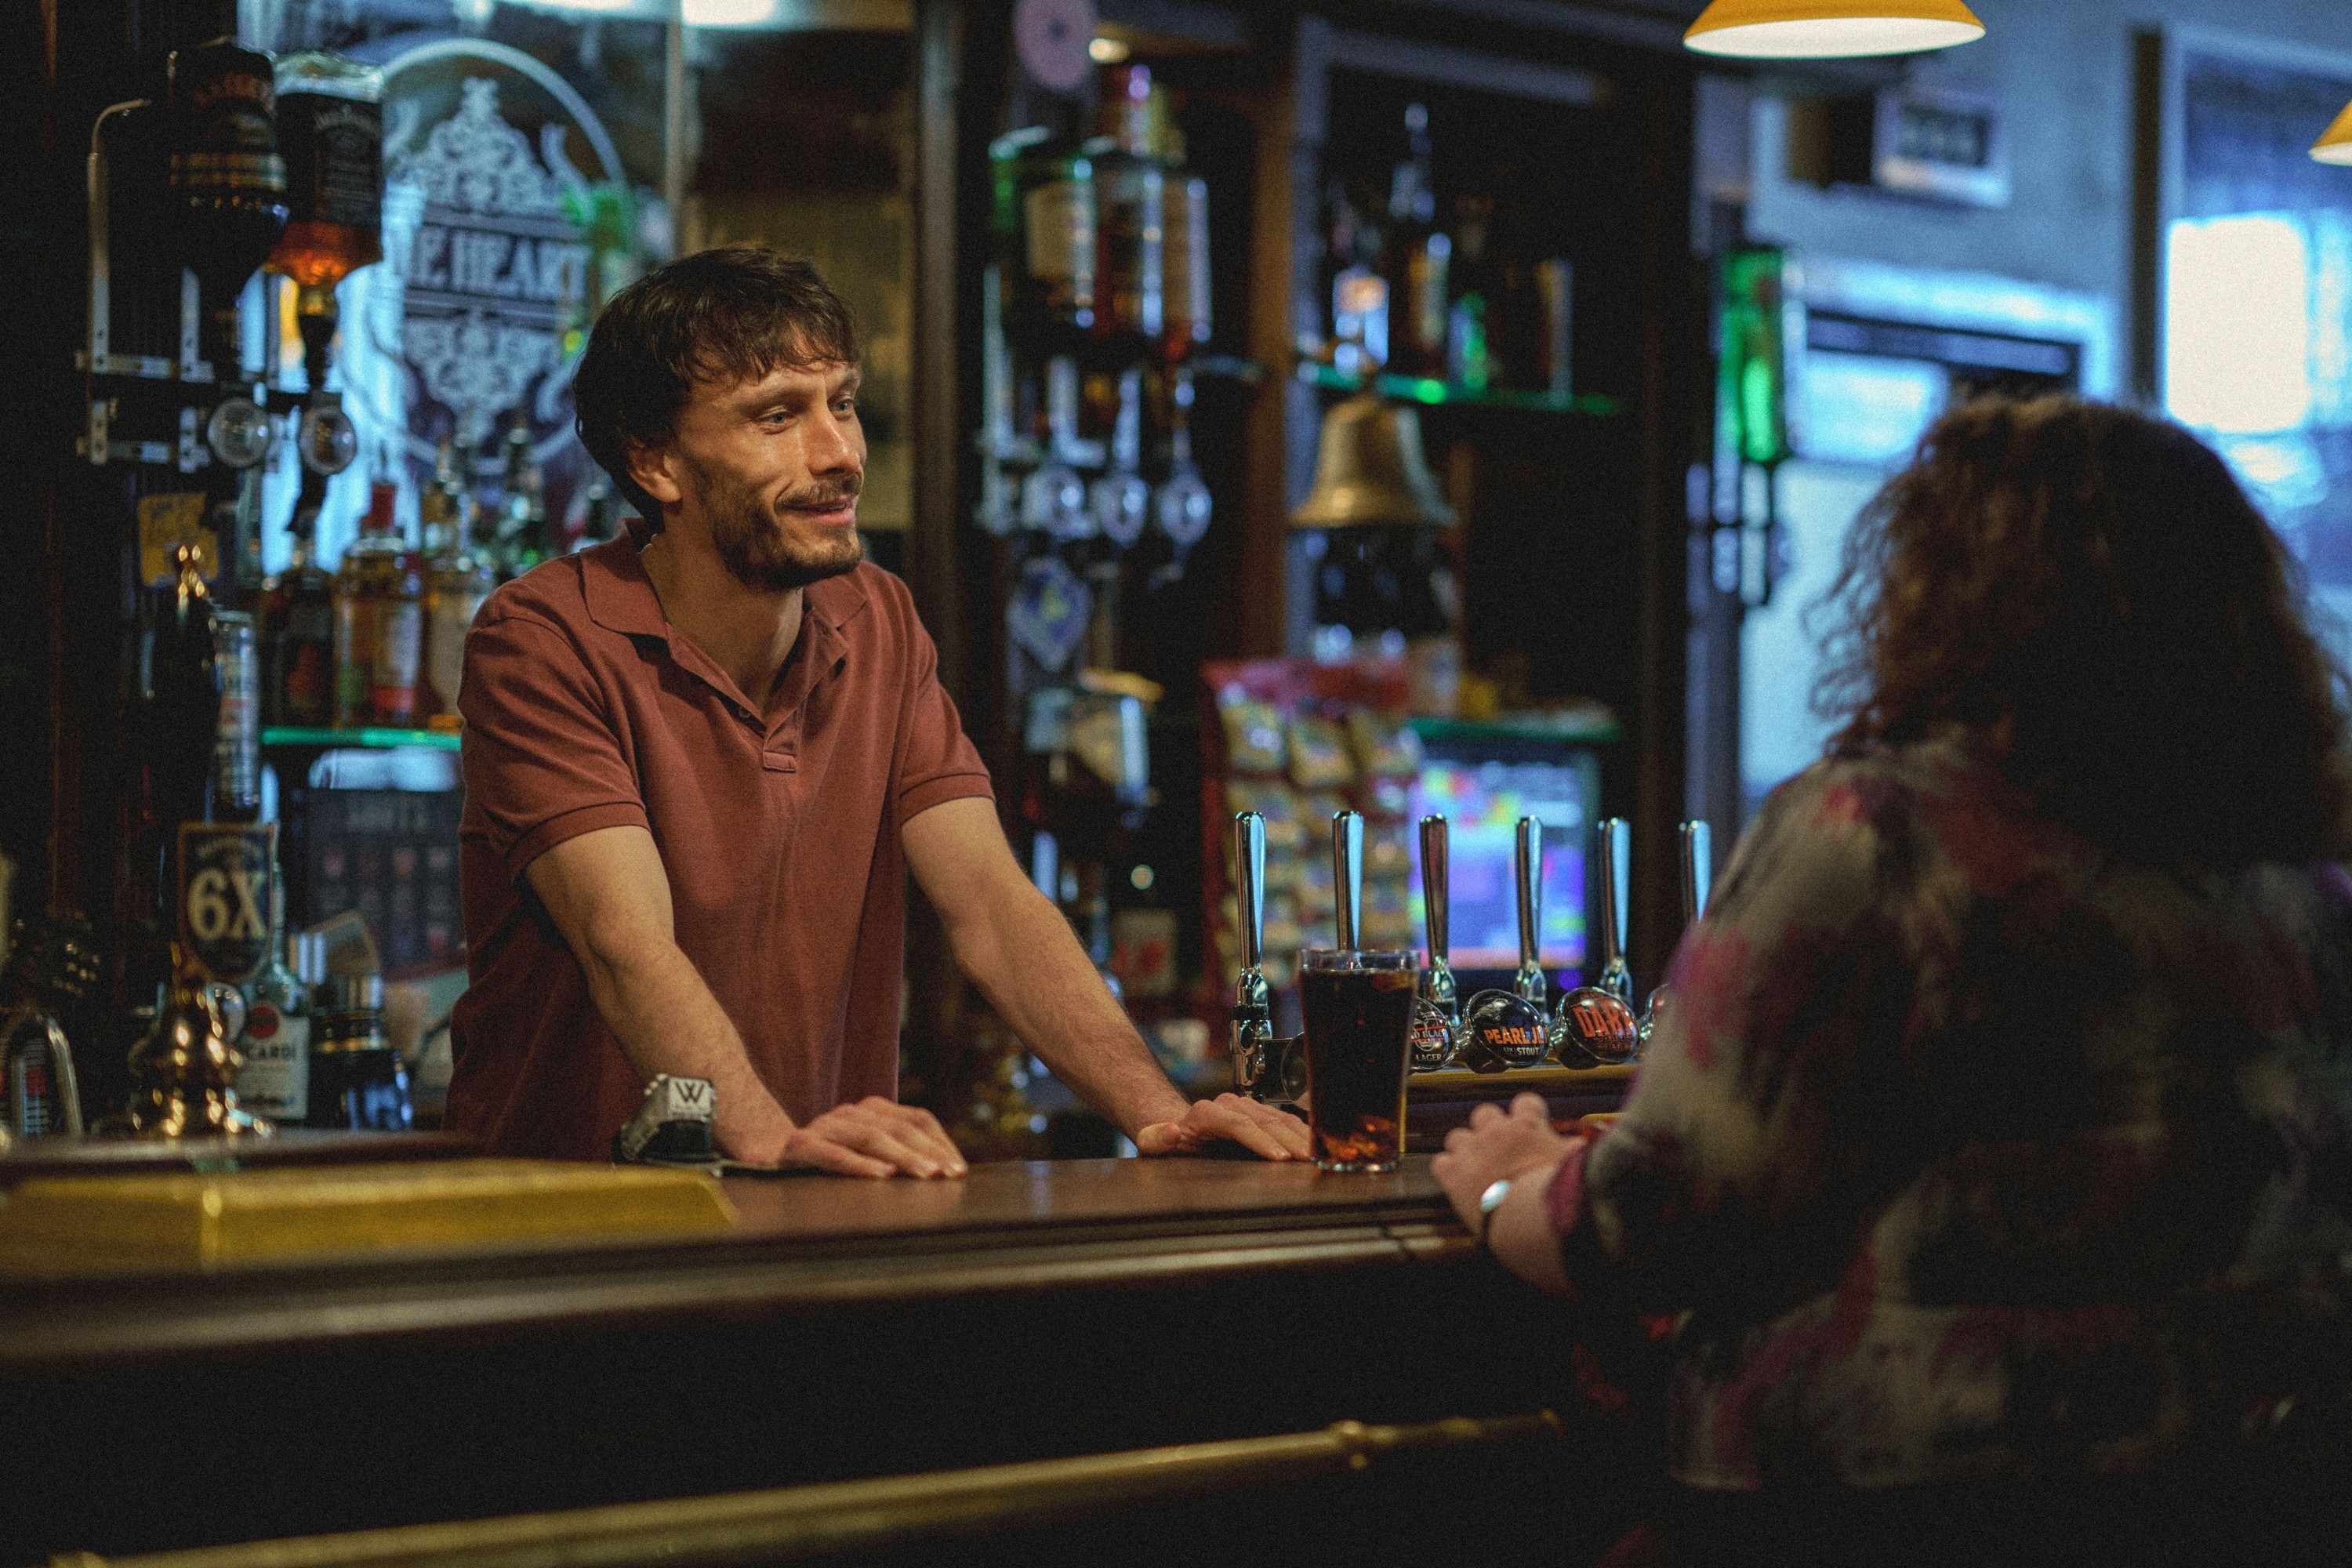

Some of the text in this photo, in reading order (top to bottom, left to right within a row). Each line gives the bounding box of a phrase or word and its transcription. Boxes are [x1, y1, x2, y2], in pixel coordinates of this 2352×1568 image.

[187, 867, 267, 942] 6X
[1422, 1029, 1444, 1038] BLAC
[1483, 1027, 1530, 1044] PEARL
[1416, 1053, 1442, 1062] LAGER
[1516, 1047, 1540, 1055] STOUT
[674, 1081, 705, 1103] W
